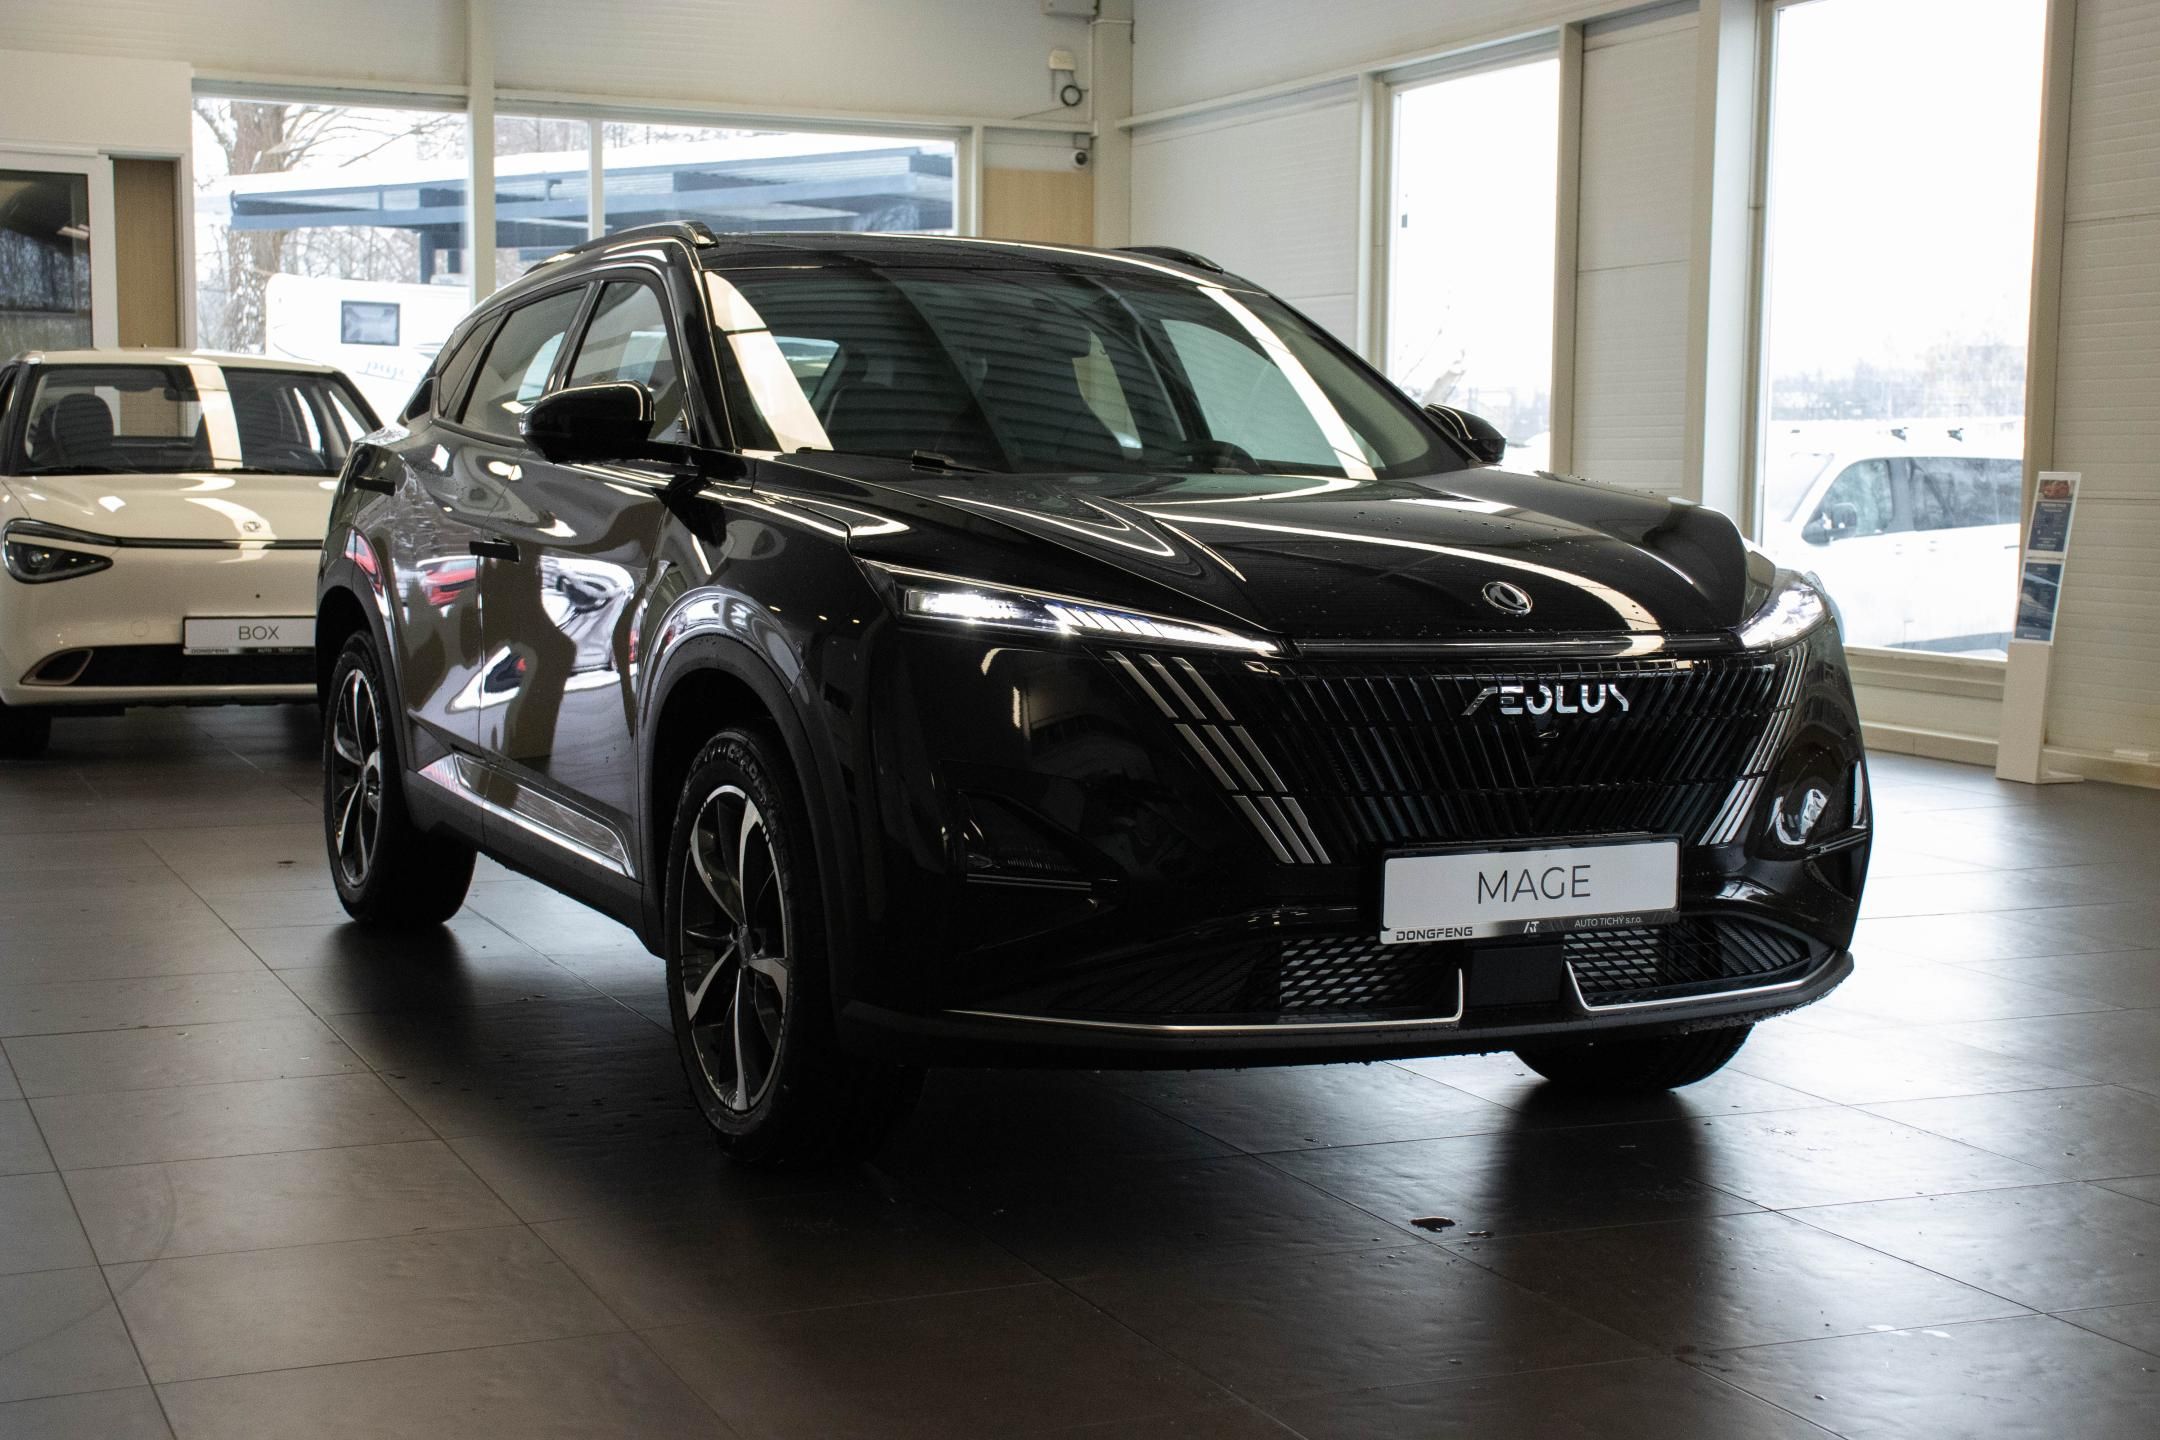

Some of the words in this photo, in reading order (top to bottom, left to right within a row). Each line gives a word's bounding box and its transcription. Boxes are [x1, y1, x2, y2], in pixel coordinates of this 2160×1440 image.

[239, 626, 279, 640] BOX
[1478, 865, 1591, 904] MAGE
[1574, 918, 1598, 928] AUTO
[1396, 927, 1473, 941] DONGFENG
